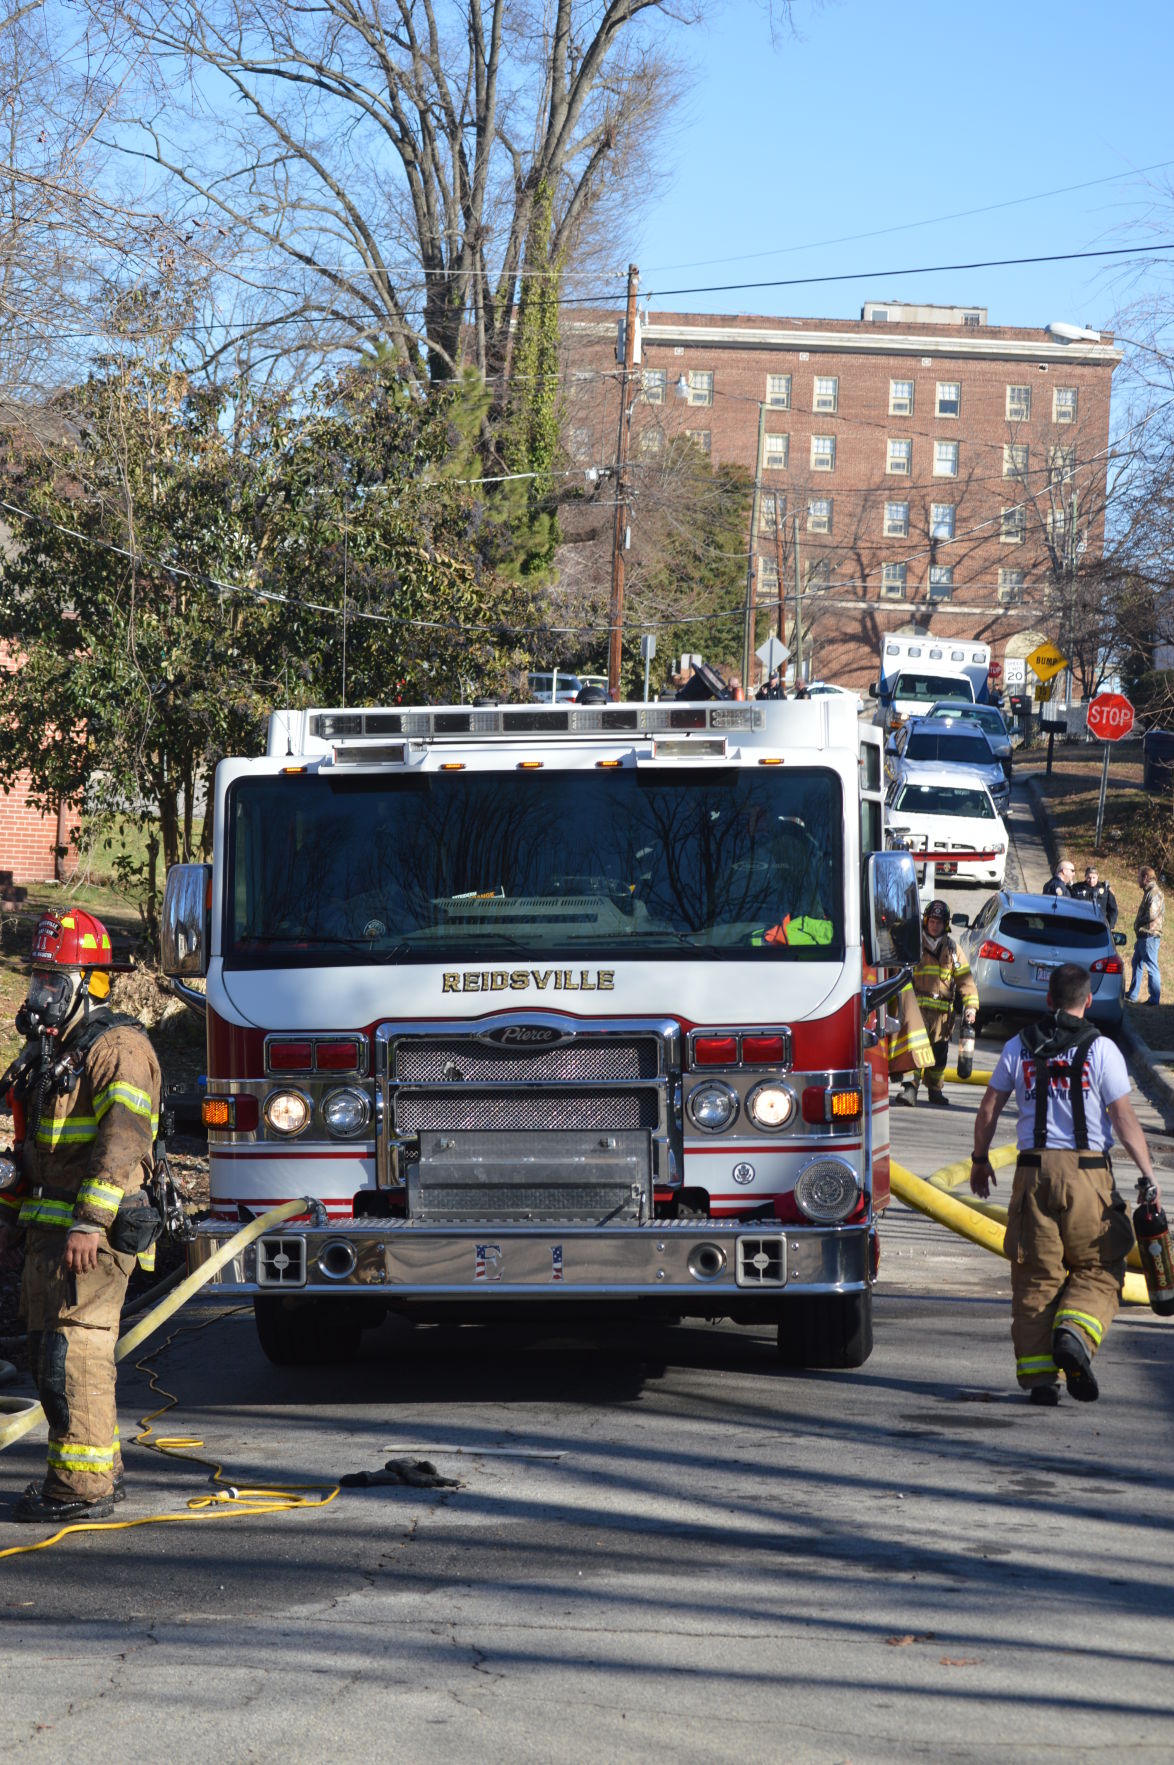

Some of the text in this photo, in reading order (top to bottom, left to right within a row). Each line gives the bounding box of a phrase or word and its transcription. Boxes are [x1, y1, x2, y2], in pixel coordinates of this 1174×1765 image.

[1036, 656, 1058, 666] BUMP
[1007, 671, 1023, 681] 20
[1090, 705, 1131, 727] STOP
[442, 970, 615, 992] REIDSVILLE
[502, 1026, 552, 1044] Pierce
[1022, 1060, 1090, 1089] FRE
[472, 1244, 504, 1281] E
